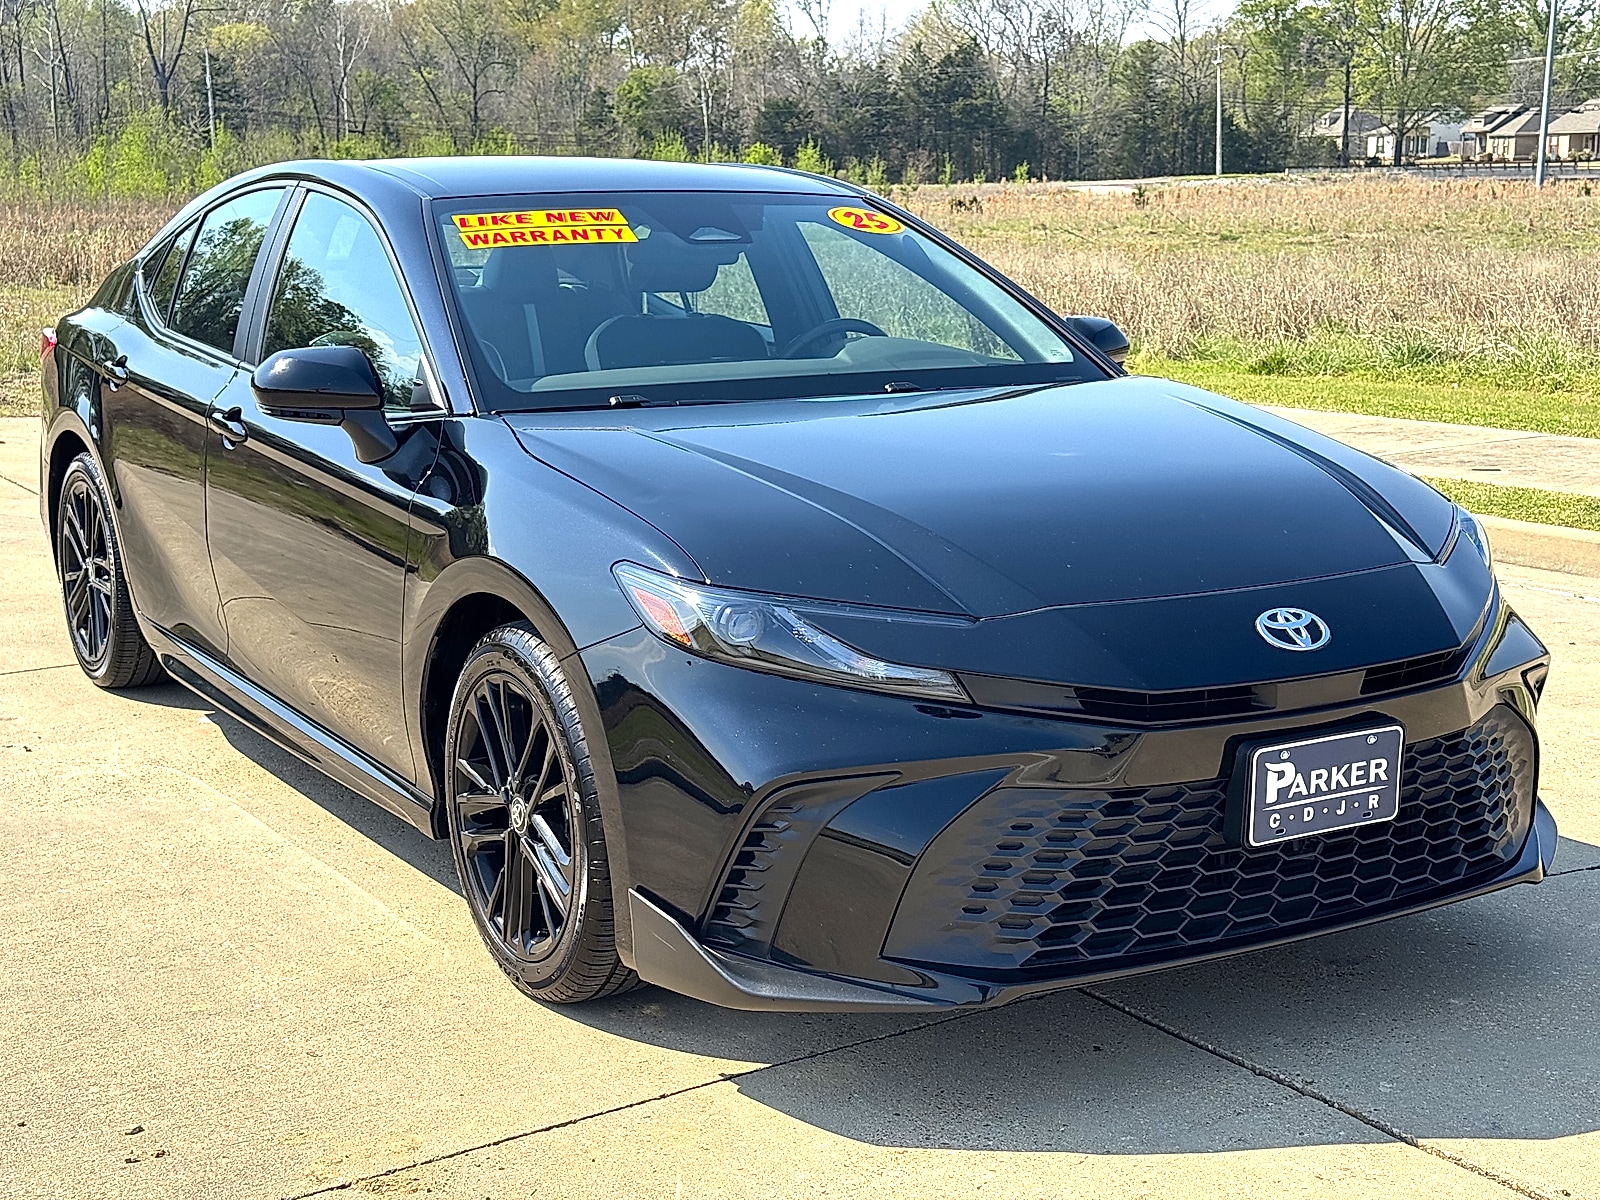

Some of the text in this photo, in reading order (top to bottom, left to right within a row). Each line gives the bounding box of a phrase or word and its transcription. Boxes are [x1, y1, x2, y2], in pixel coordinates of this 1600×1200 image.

[458, 211, 616, 228] LIKE NEW
[842, 211, 889, 229] 25
[465, 228, 626, 246] WARRANTY
[1264, 758, 1389, 804] PARKER
